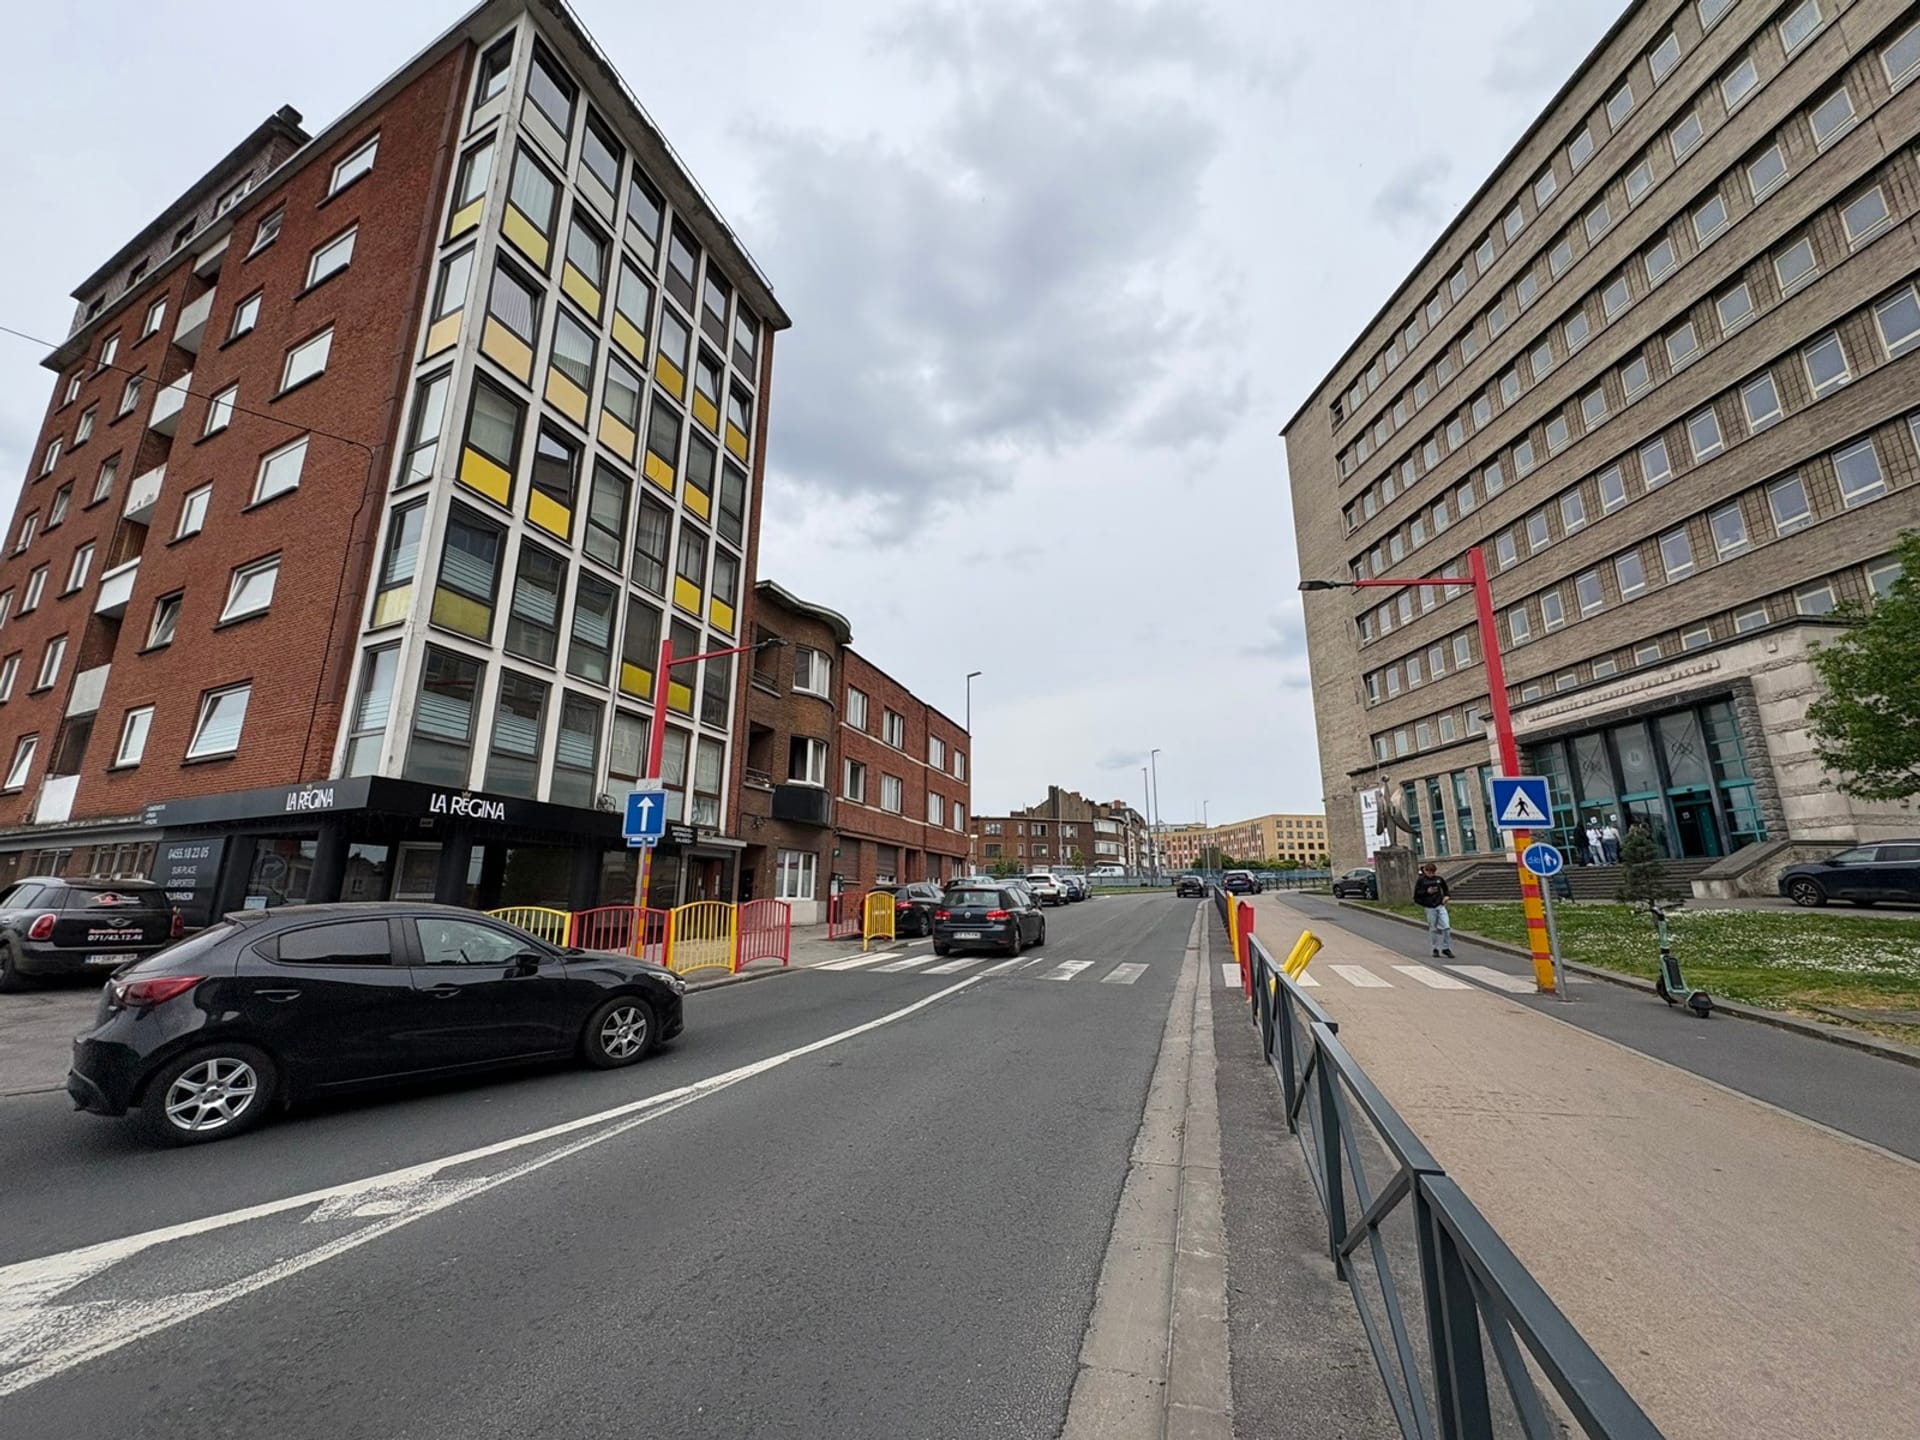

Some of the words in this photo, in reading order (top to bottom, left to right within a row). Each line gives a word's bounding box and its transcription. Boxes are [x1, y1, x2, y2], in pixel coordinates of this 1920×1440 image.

[285, 792, 297, 811] LA
[429, 793, 447, 814] LA
[450, 796, 505, 821] REGINA
